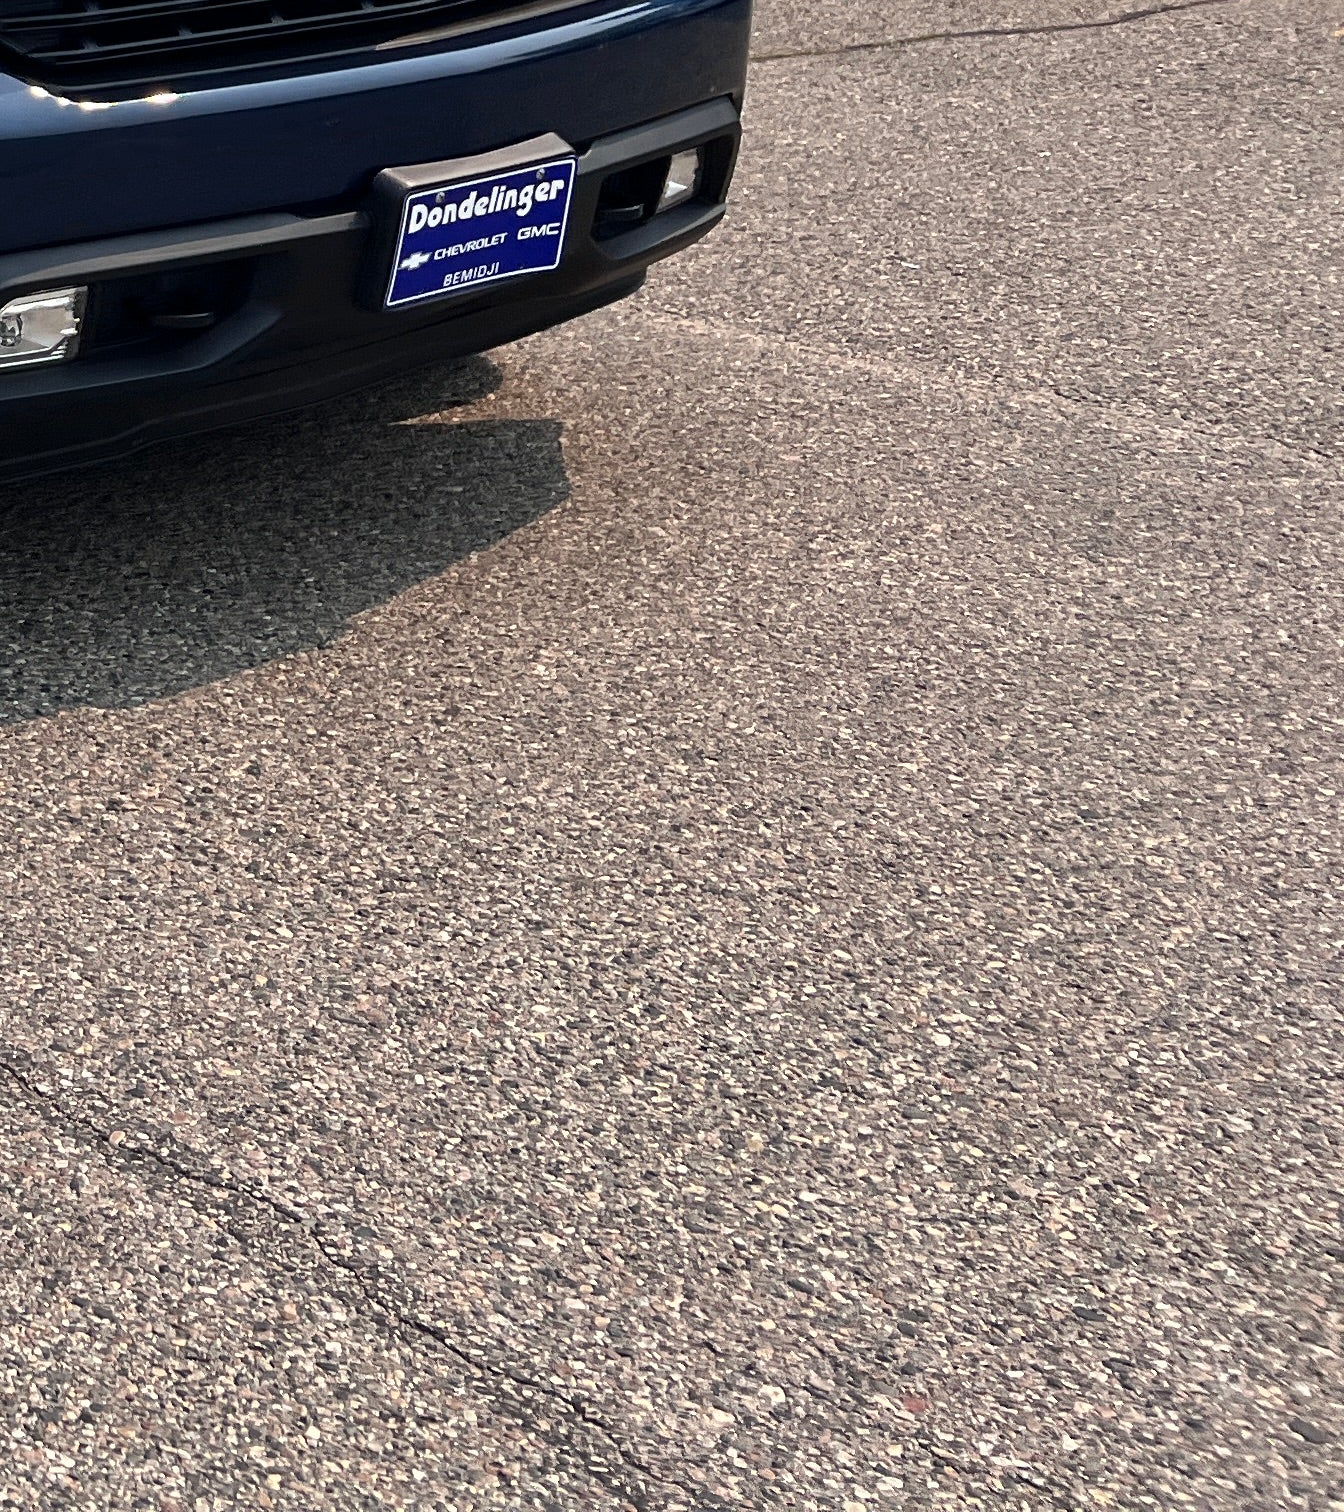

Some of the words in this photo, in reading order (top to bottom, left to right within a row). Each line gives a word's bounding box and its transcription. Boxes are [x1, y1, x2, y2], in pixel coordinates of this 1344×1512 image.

[407, 178, 565, 234] Dondelinger
[433, 232, 509, 260] CHEVROLET
[517, 222, 562, 241] GMC
[443, 261, 499, 287] BEMIDJI
